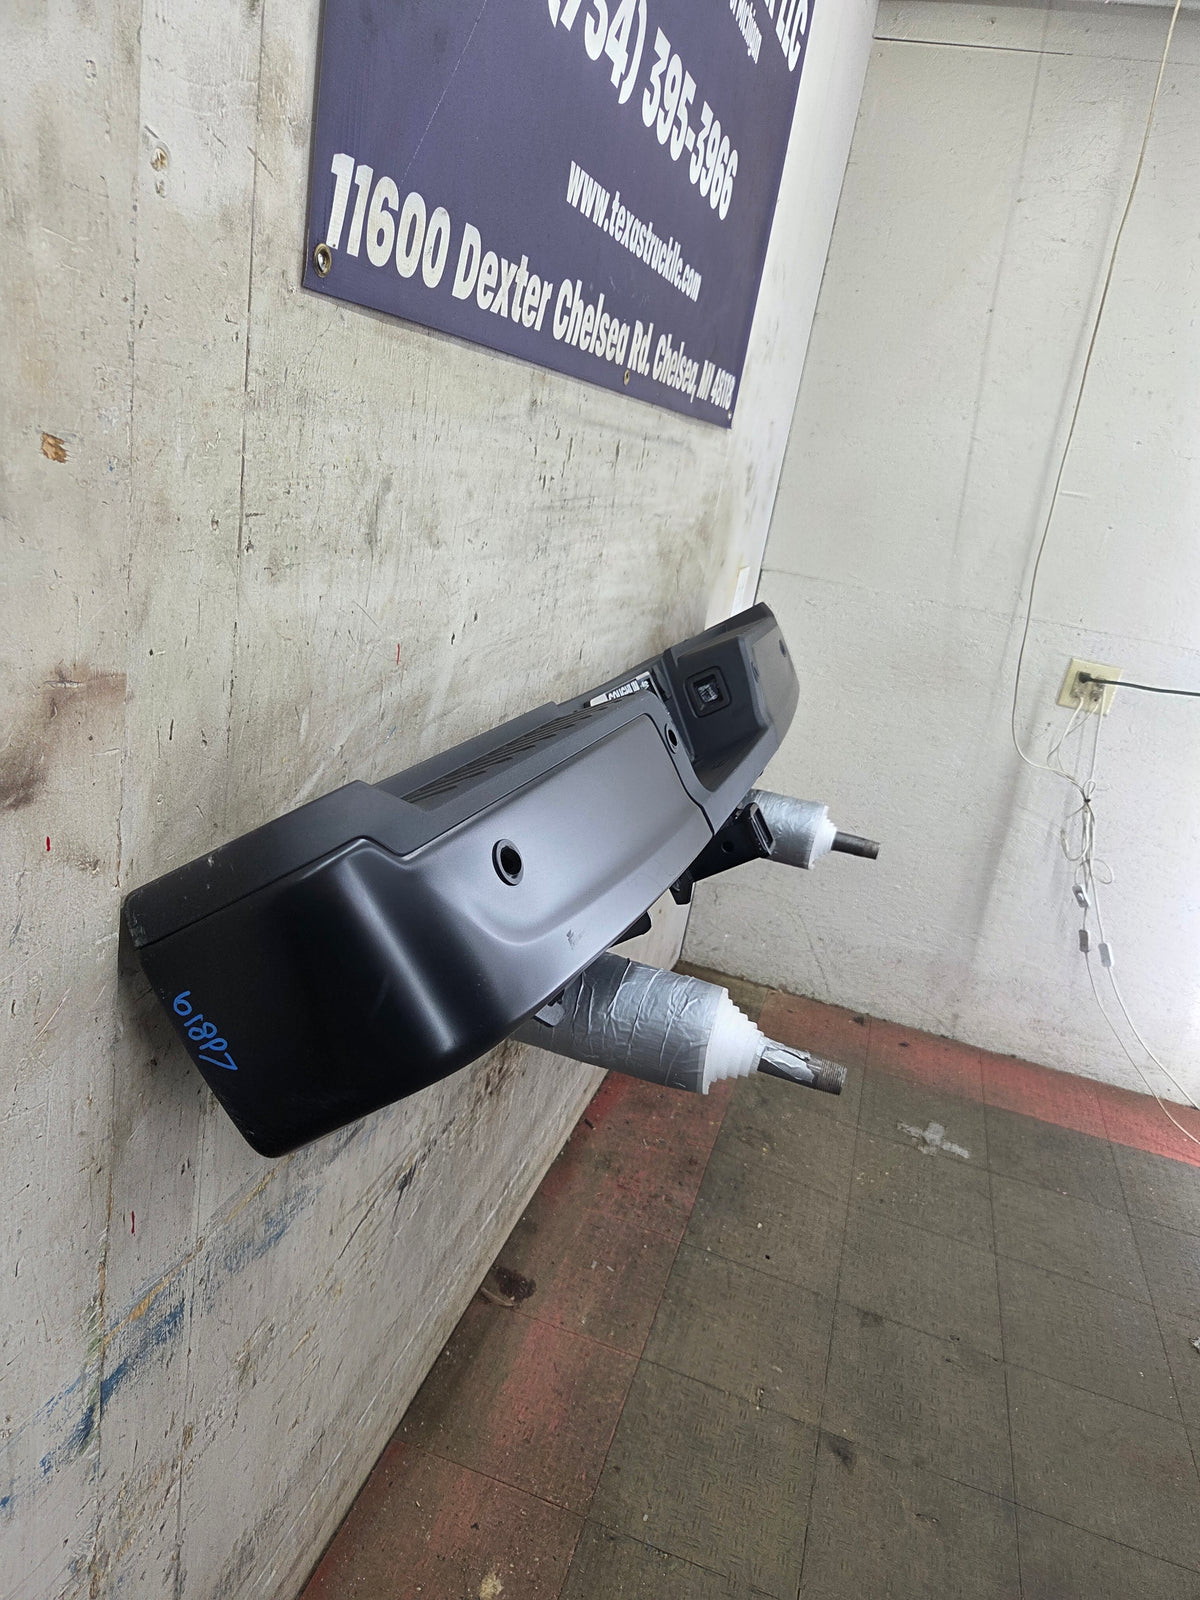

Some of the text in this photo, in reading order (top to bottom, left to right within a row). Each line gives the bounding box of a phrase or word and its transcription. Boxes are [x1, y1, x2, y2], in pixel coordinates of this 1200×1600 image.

[547, 0, 739, 221] 34) 395-3966
[325, 152, 451, 289] 11600
[451, 222, 554, 332] Dexter
[552, 278, 631, 366] Chelsea
[627, 319, 654, 377] Rd.
[652, 333, 700, 404] Chelsea,
[696, 359, 716, 401] MI
[566, 160, 702, 303] www.texastruckllc.com
